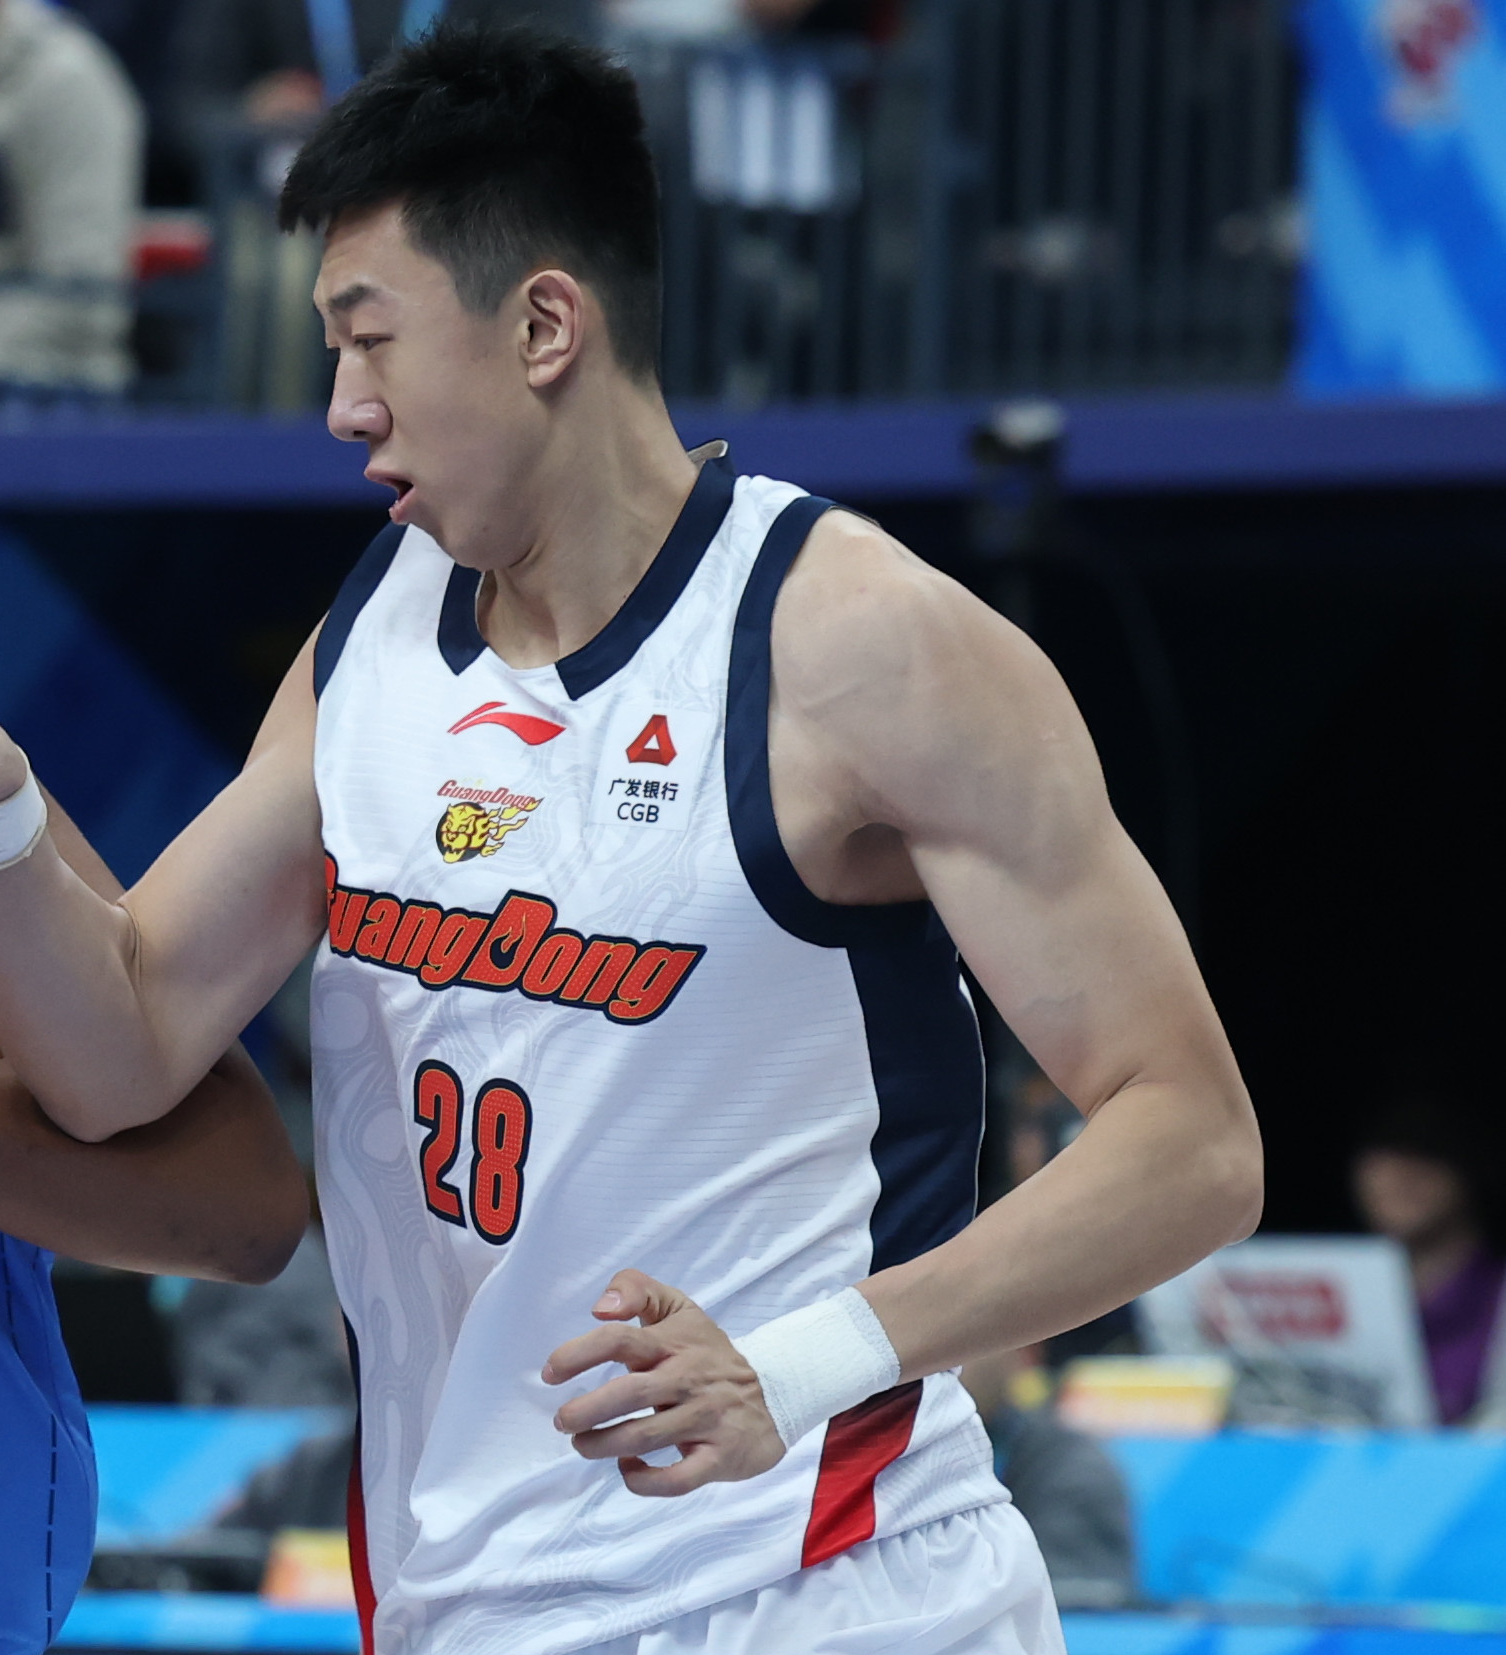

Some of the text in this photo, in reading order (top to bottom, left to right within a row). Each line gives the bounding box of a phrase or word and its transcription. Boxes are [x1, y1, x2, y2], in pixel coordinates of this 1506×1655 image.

[437, 779, 540, 812] GuangDong
[608, 778, 680, 801] 广发银行
[616, 801, 661, 823] CGB
[324, 850, 708, 1026] uangDong
[413, 1058, 533, 1246] 28
